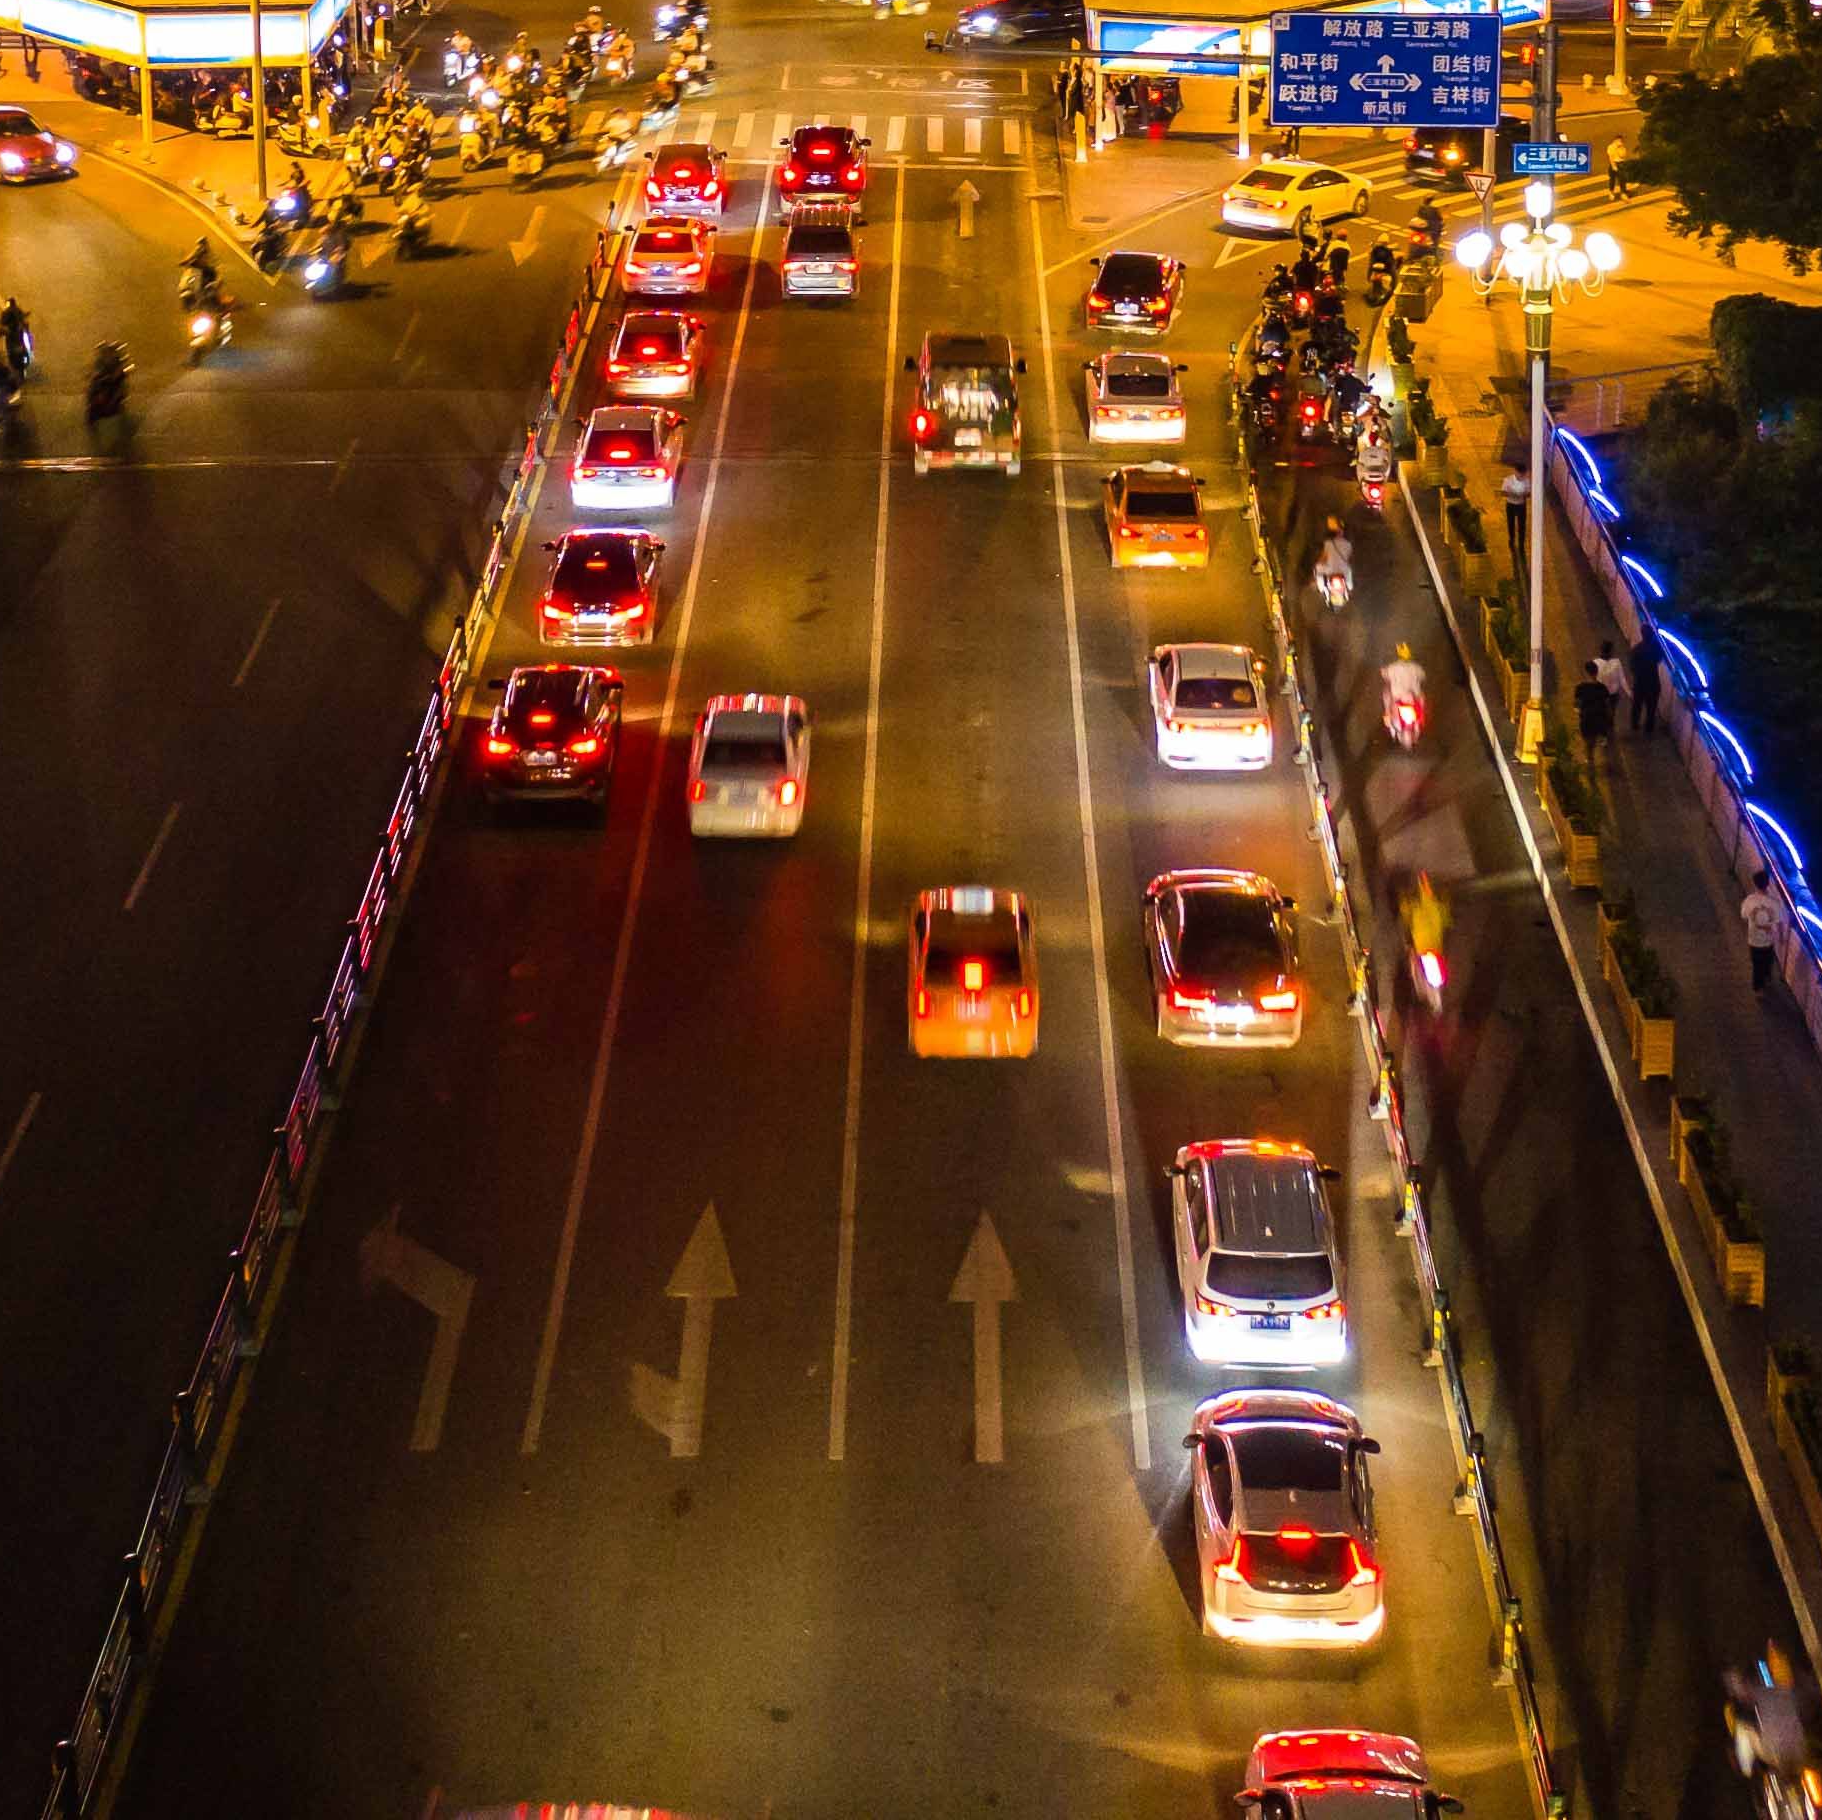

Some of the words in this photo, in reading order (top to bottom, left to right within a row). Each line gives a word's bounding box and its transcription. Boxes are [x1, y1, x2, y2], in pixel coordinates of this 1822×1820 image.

[1323, 19, 1384, 38] 解放路
[1391, 21, 1471, 40] 三亚湾路
[1280, 53, 1339, 72] 和平街
[1432, 55, 1492, 74] 团结街
[1279, 84, 1339, 103] 跃进街
[1431, 86, 1492, 105] 吉祥街
[1362, 101, 1407, 116] 新风街
